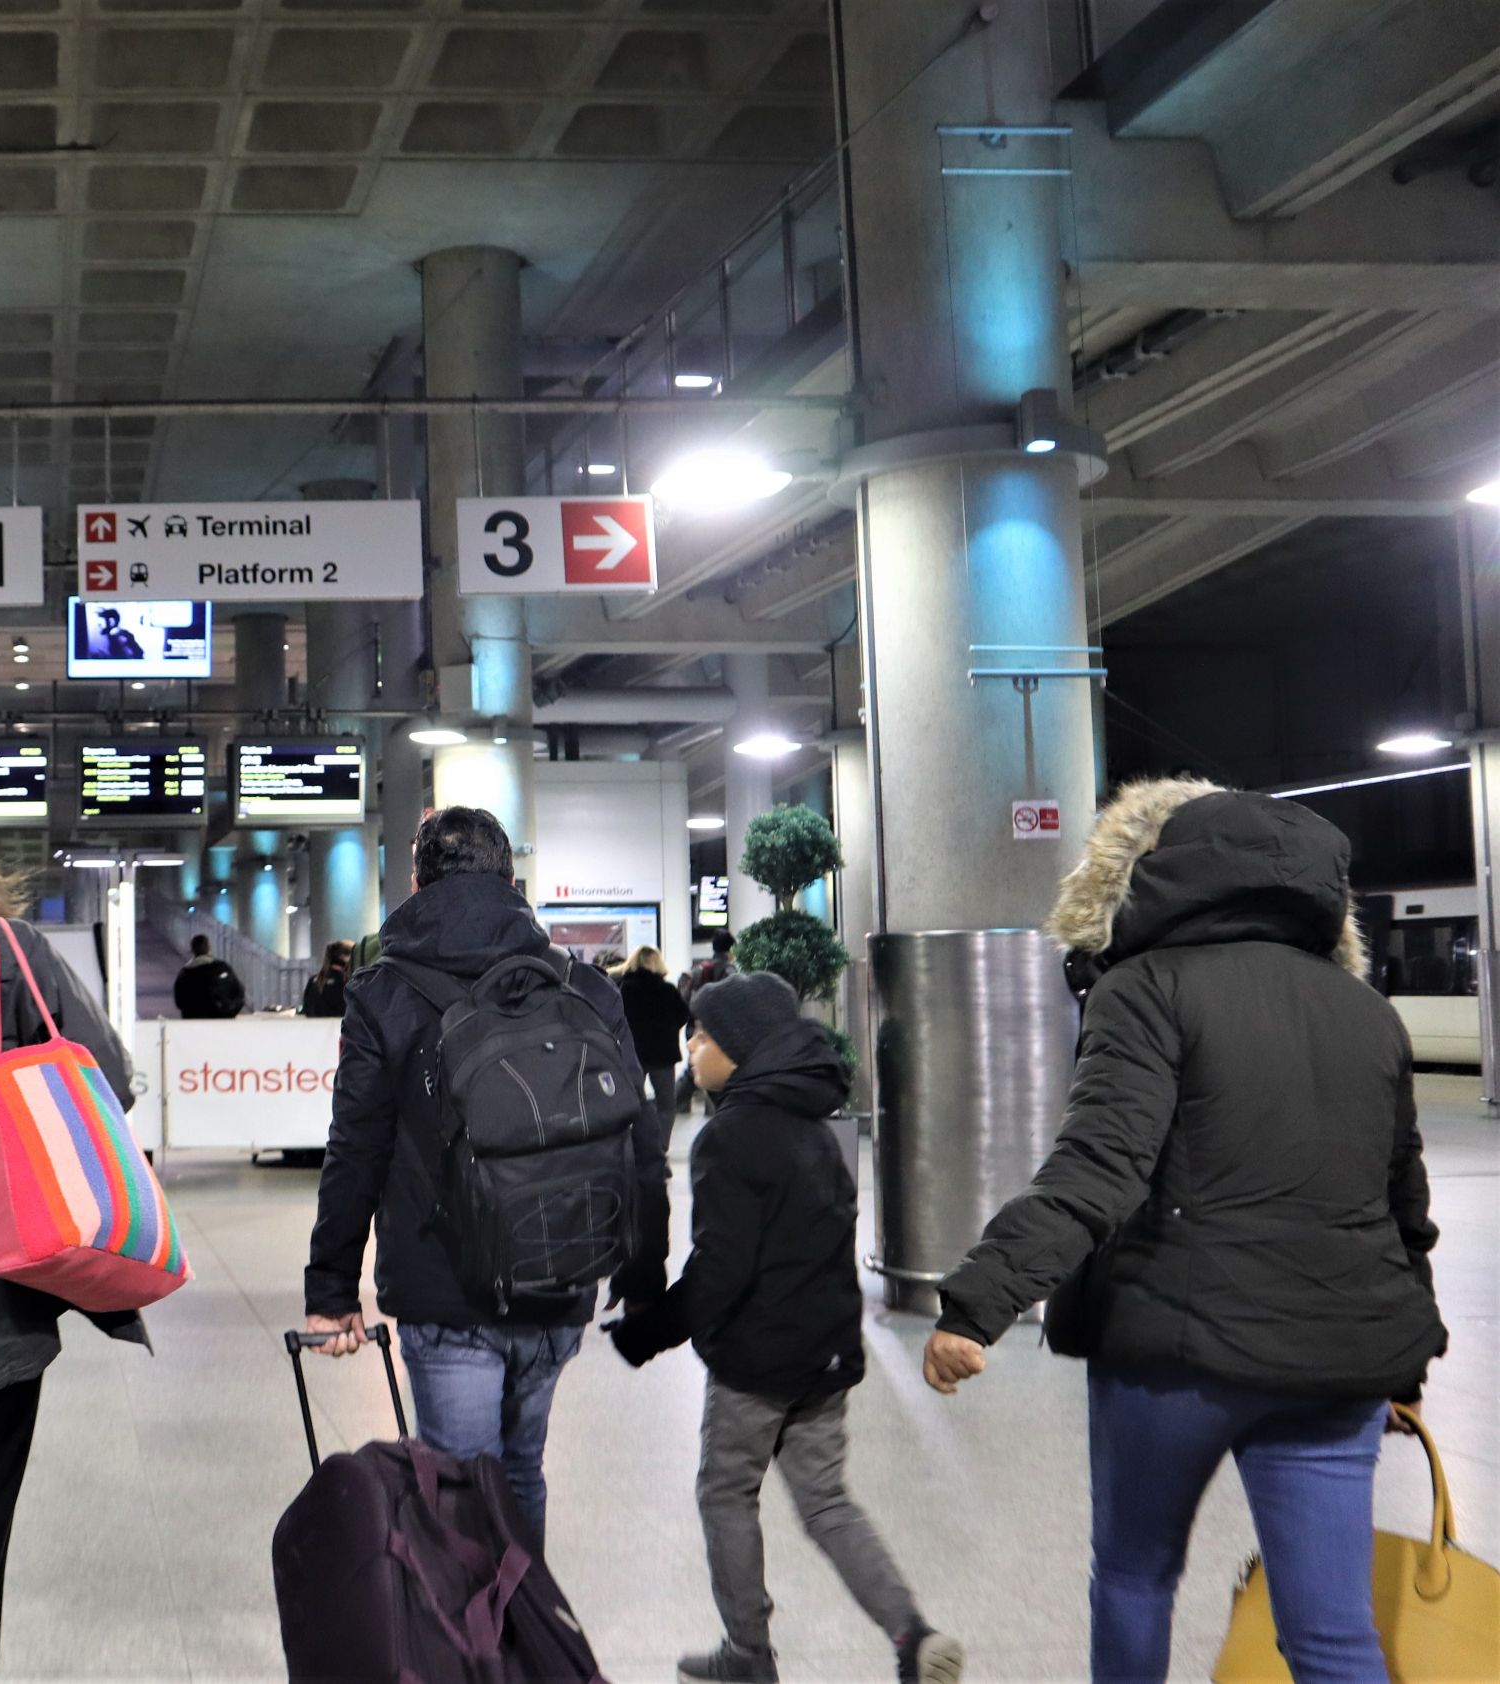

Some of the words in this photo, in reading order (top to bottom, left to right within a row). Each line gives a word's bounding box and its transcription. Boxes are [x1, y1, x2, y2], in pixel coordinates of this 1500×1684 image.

[196, 514, 311, 537] Terminal
[483, 510, 534, 577] 3
[198, 562, 314, 585] Platform
[323, 561, 338, 583] 2
[571, 885, 633, 897] Information
